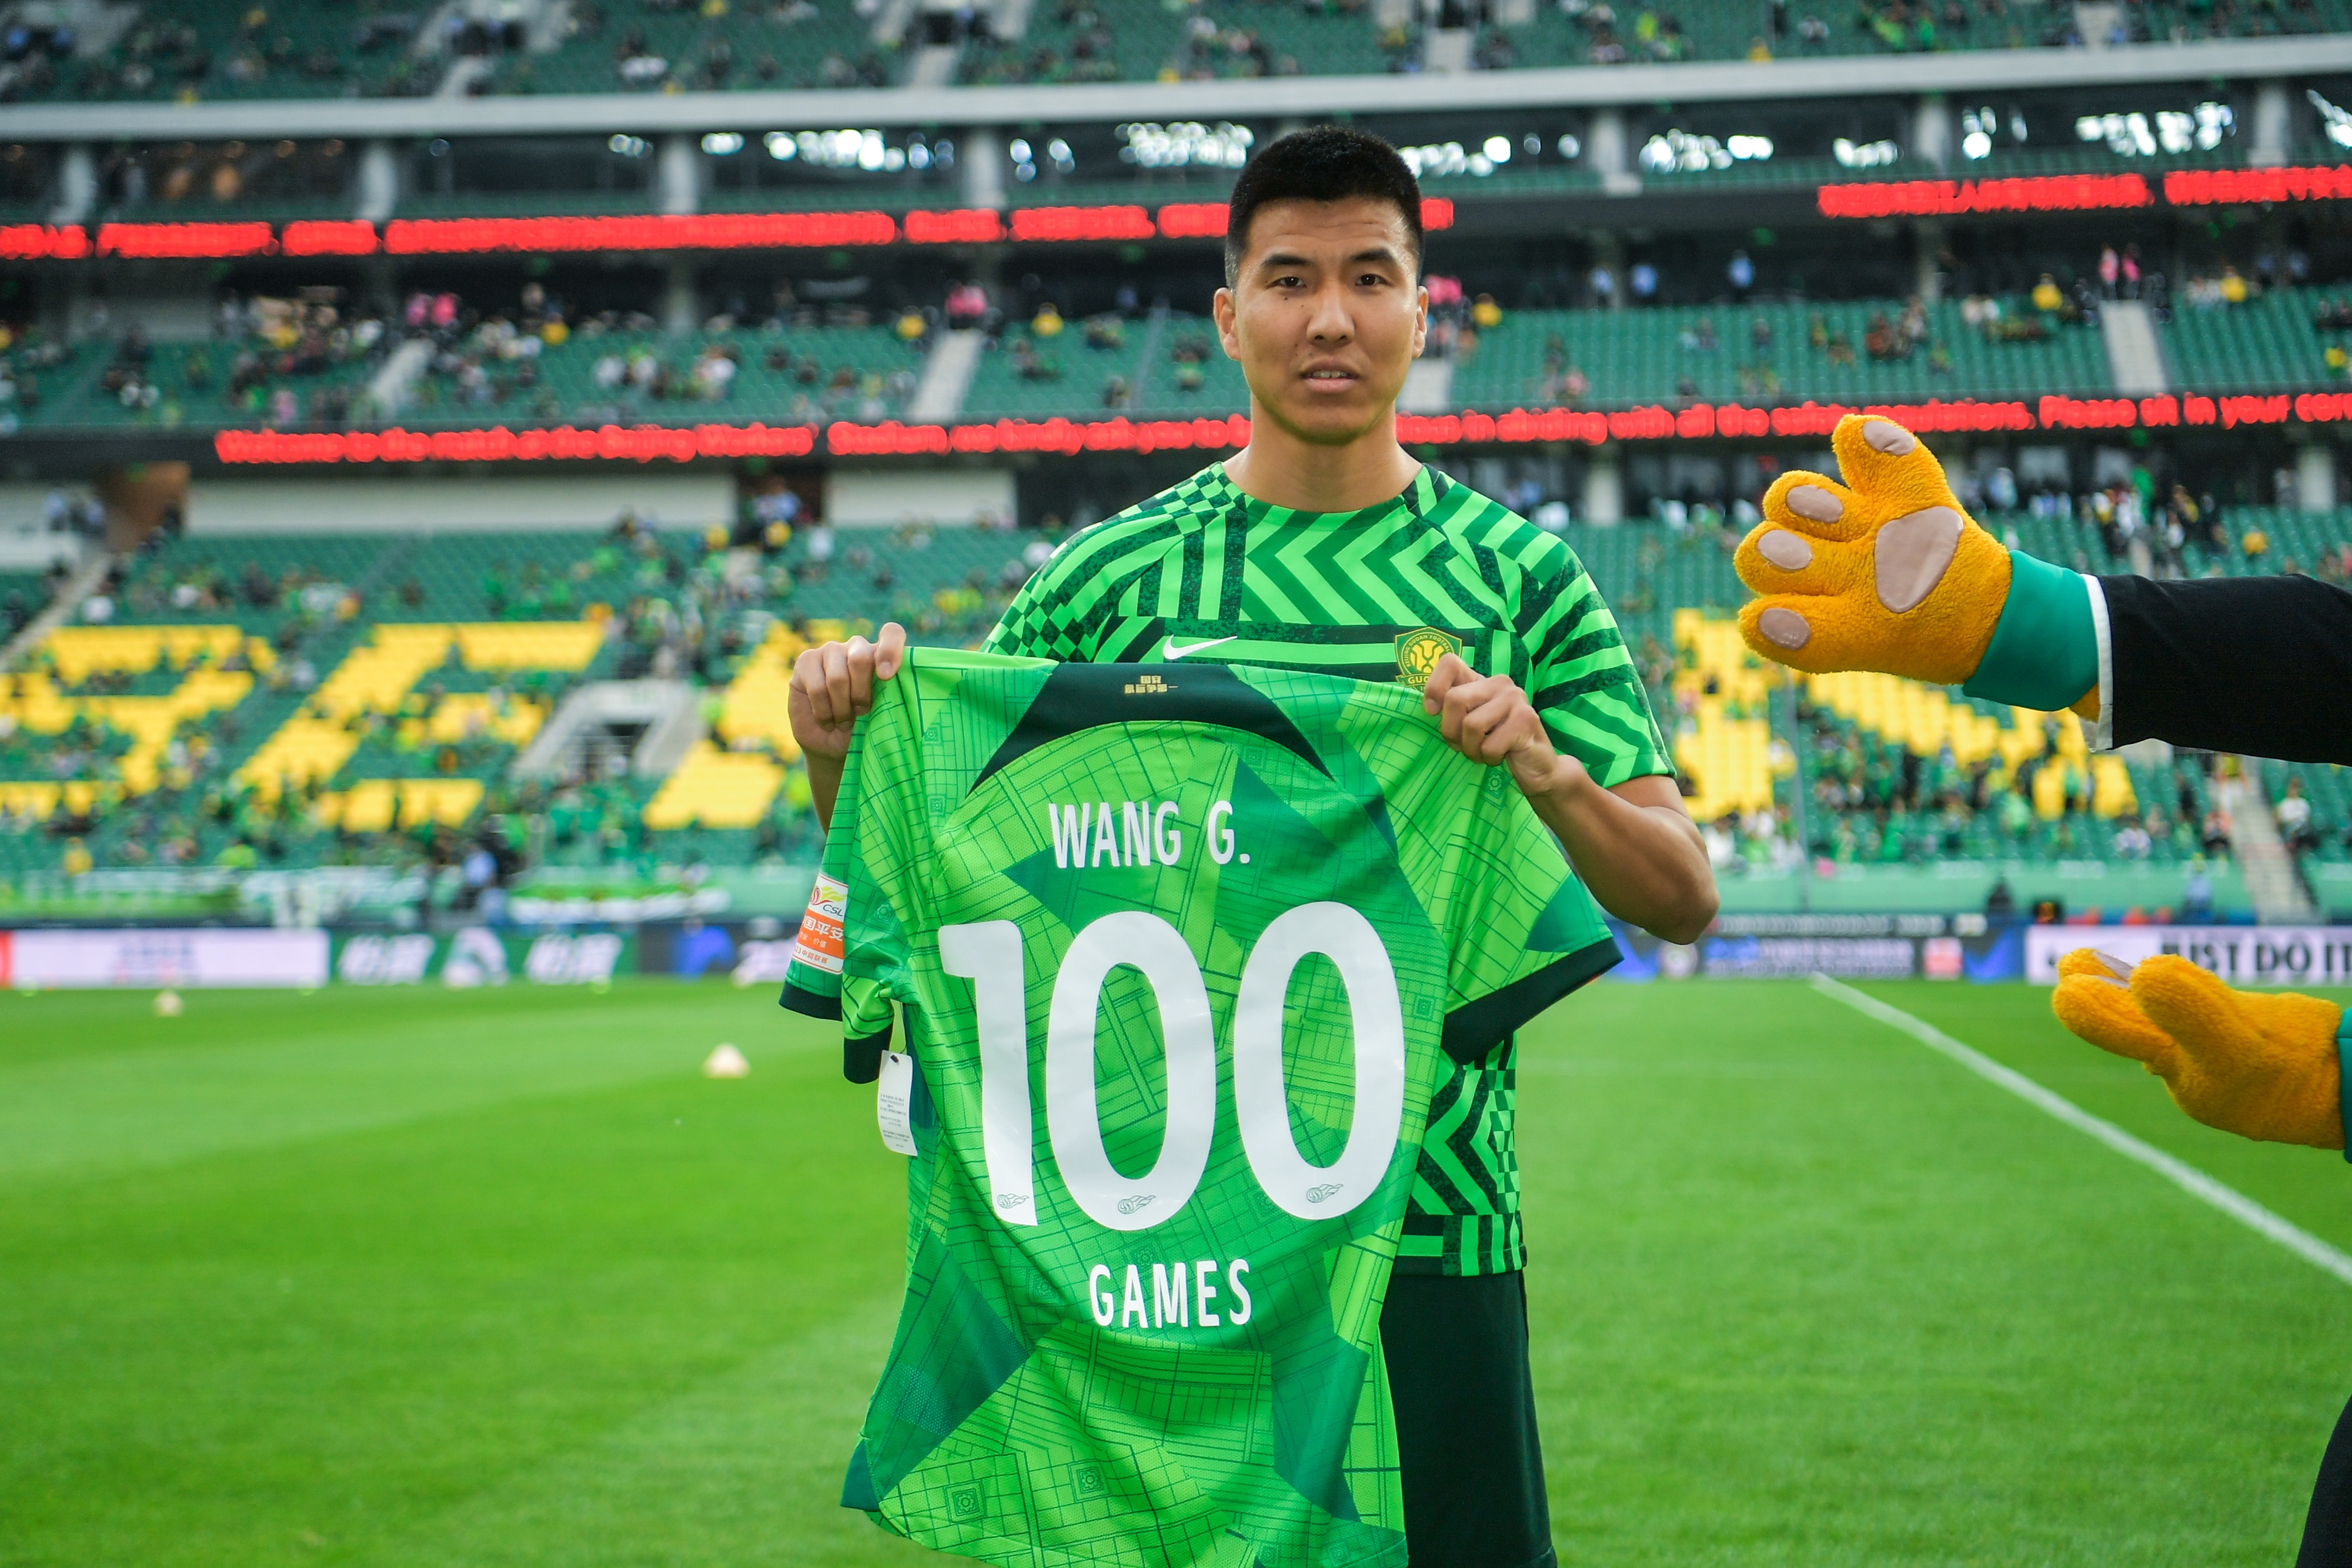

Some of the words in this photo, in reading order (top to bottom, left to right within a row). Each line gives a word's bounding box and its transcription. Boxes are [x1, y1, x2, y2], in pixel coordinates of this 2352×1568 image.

[1409, 634, 1428, 647] GUOAN
[1429, 634, 1451, 653] FOOTBAL
[1408, 676, 1429, 684] GUO
[1048, 800, 1182, 869] WANG
[1208, 800, 1251, 865] G.
[823, 904, 844, 917] CSL
[802, 915, 844, 942] 国平安
[2256, 941, 2312, 973] DO
[938, 901, 1405, 1231] 100
[1088, 1258, 1252, 1329] GAMES
